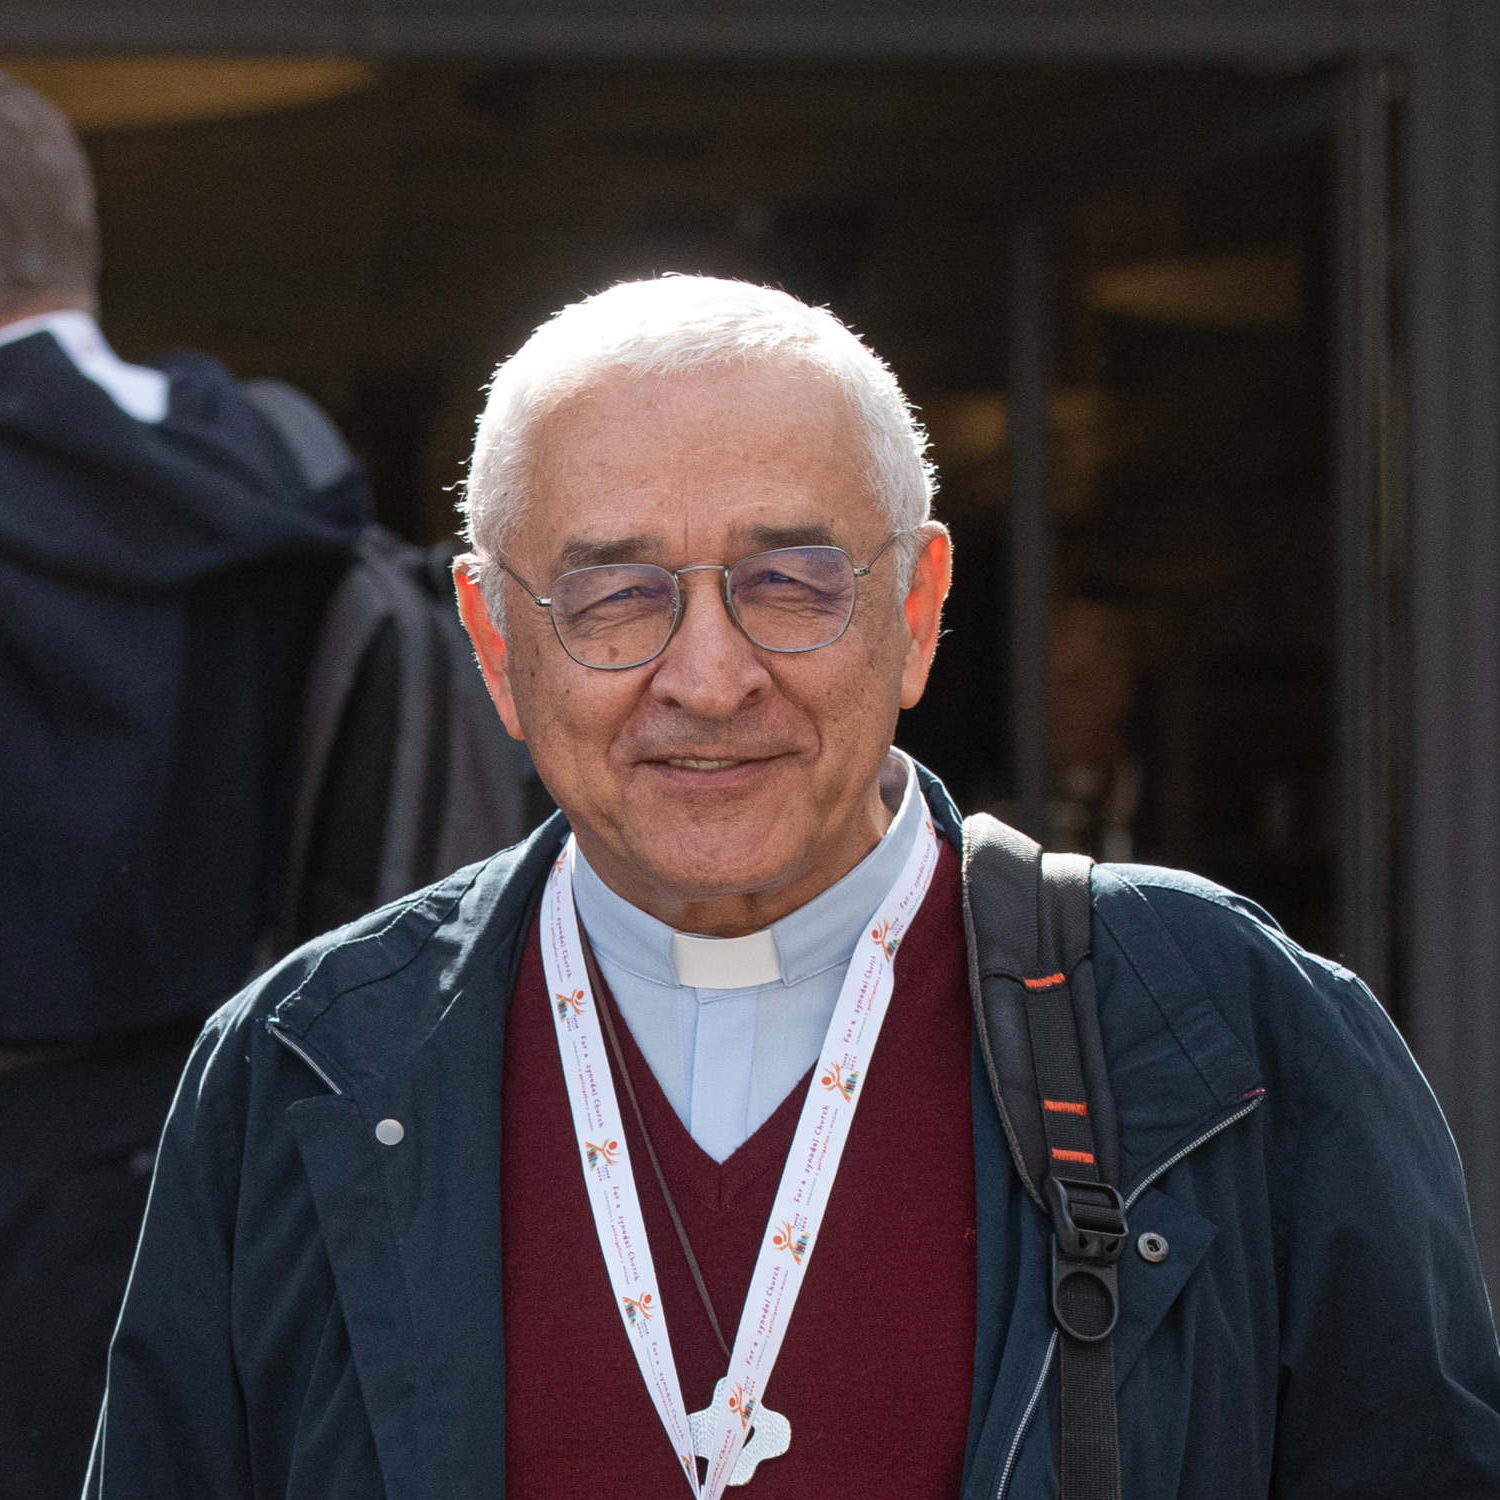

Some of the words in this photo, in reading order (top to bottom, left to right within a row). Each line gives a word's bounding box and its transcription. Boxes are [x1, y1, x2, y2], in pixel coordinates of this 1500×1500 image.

[898, 895, 910, 910] For
[842, 1028, 853, 1043] For
[852, 980, 870, 1014] synodal
[863, 955, 877, 979] Church
[580, 1035, 588, 1049] For
[584, 1064, 598, 1096] synodal
[593, 1098, 605, 1128] Church
[793, 1188, 803, 1203] For
[803, 1138, 821, 1174] synodal
[814, 1105, 830, 1135] Church
[611, 1186, 620, 1200] For
[616, 1215, 632, 1248] synodal
[627, 1251, 640, 1281] Church
[651, 1341, 659, 1356] For
[745, 1350, 755, 1365] For
[755, 1299, 772, 1335] synodal
[765, 1265, 781, 1296] Church
